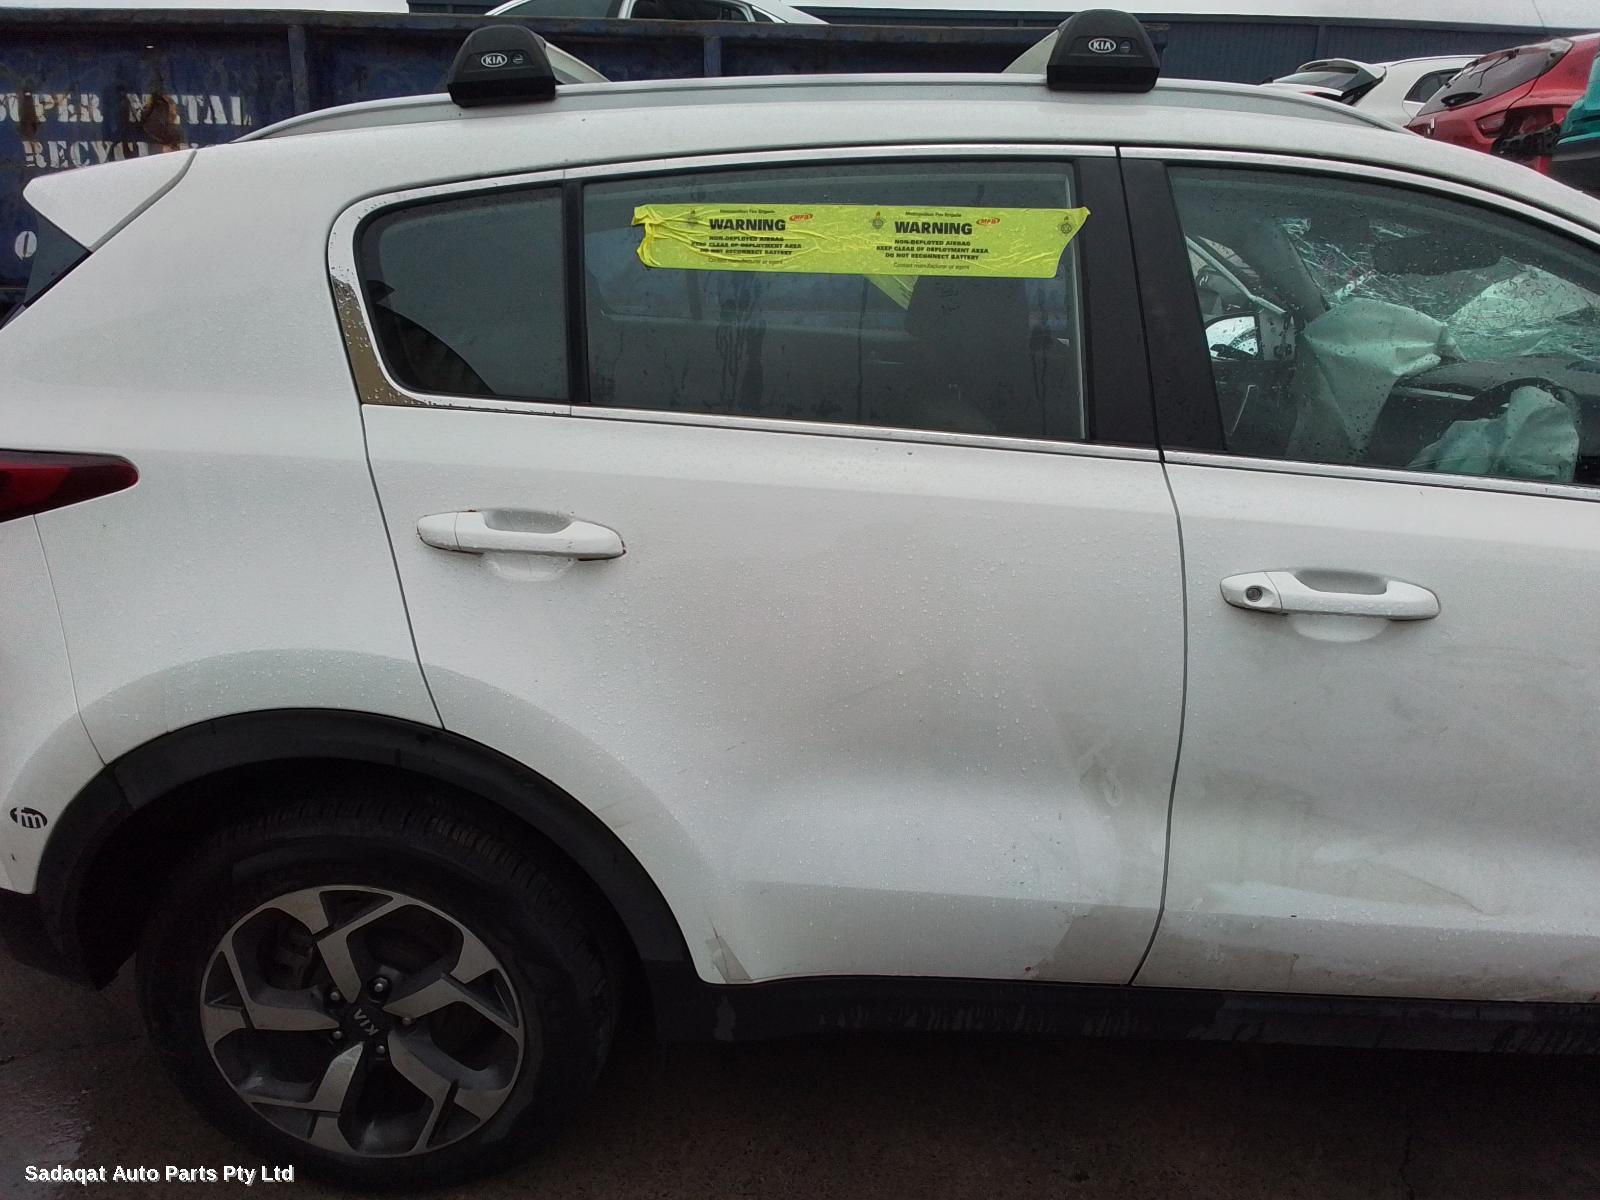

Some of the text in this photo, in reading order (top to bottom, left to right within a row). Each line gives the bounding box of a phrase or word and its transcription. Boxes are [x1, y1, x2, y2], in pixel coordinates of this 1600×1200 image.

[1092, 40, 1112, 50] KIA
[484, 55, 504, 65] KIA
[710, 219, 785, 231] WARNING
[895, 221, 973, 235] WARNING
